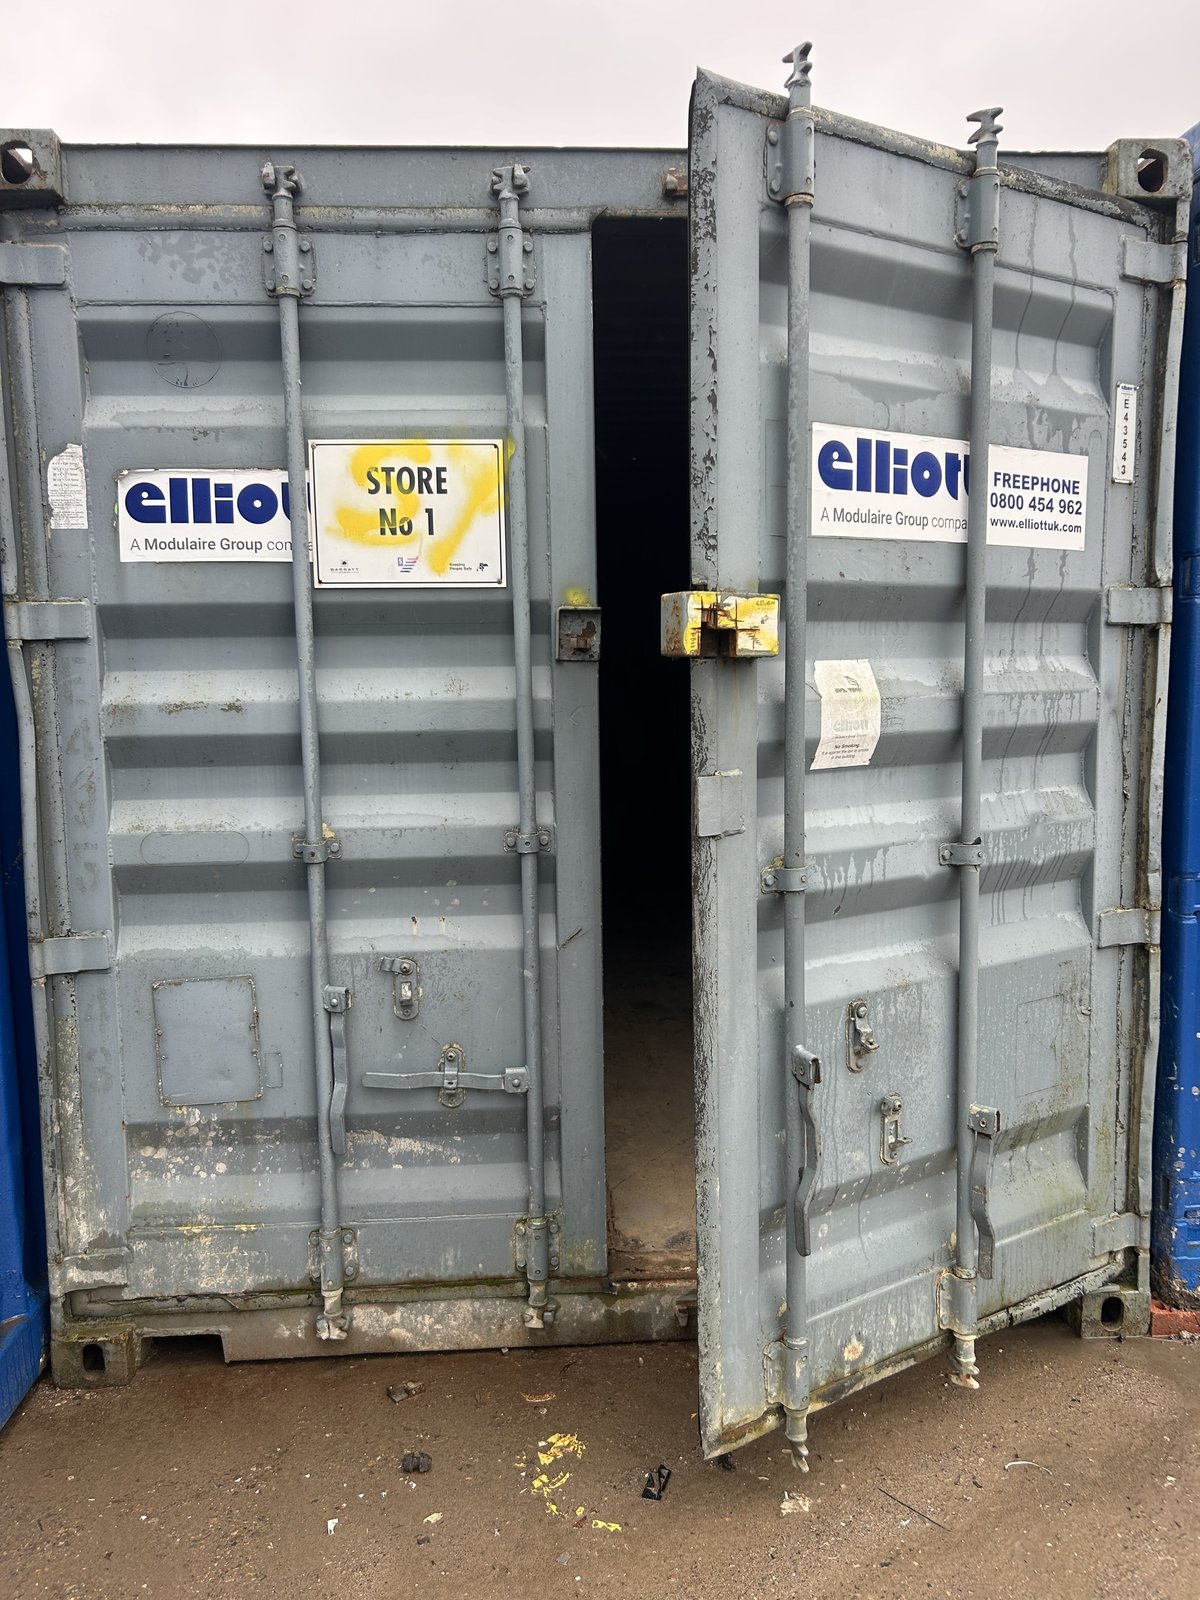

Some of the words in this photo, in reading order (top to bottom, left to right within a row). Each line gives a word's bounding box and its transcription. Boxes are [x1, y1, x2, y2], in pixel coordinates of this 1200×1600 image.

[1120, 398, 1130, 475] E43543
[366, 466, 448, 495] STORE
[993, 471, 1080, 496] FREEPHONE
[125, 477, 311, 525] ellio
[990, 492, 1024, 510] 0800
[1028, 496, 1054, 513] 454
[1058, 499, 1083, 515] 962
[379, 508, 413, 536] No
[424, 508, 435, 536] 1
[820, 507, 830, 522] A
[833, 507, 893, 526] Modulaire
[895, 512, 929, 530] Group
[931, 516, 968, 532] compa
[990, 518, 1082, 533] www.elliottuk.com
[130, 538, 141, 551] A
[144, 537, 217, 551] Modulaire
[220, 537, 263, 554] Group
